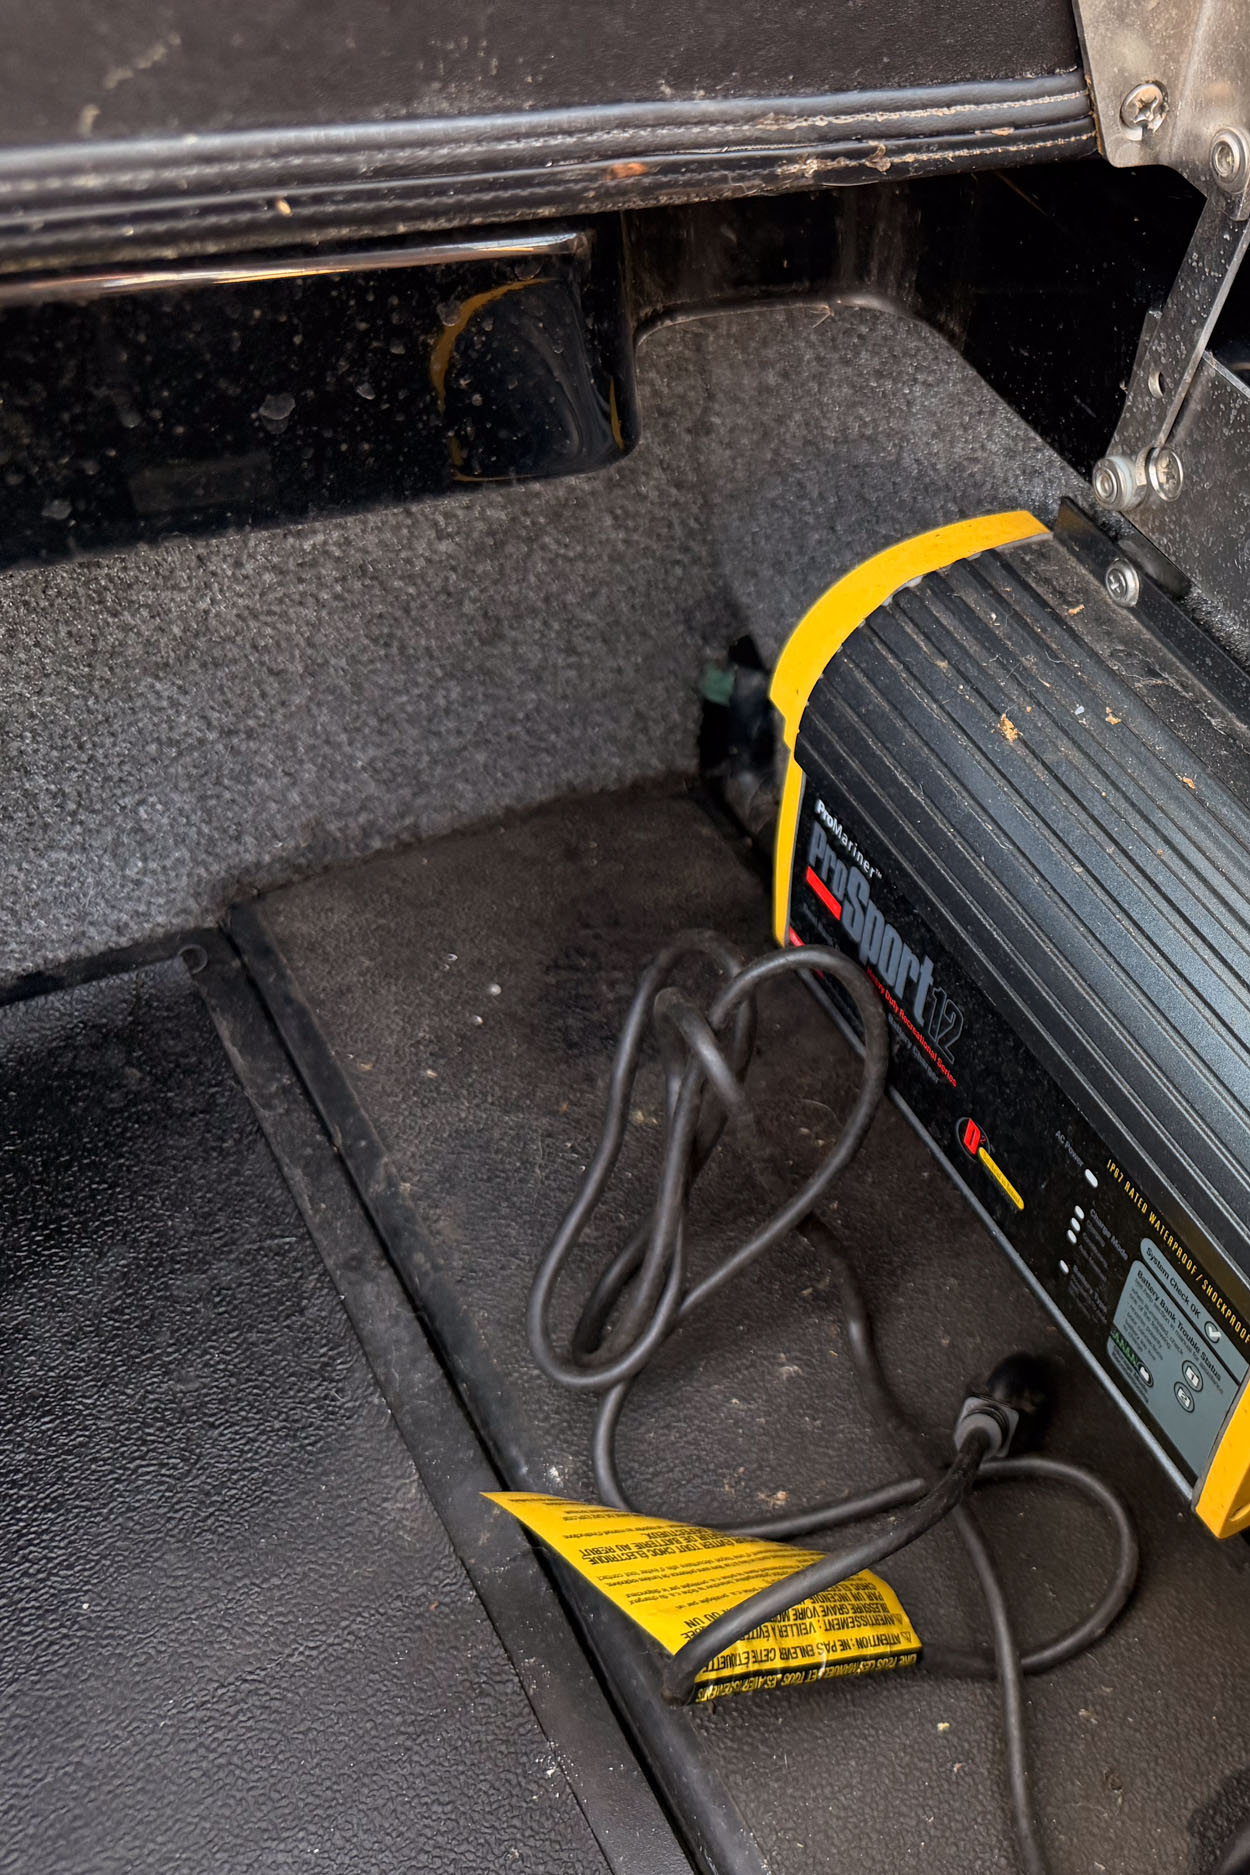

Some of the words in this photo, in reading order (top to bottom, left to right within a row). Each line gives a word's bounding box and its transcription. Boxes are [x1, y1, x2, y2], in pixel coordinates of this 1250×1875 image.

[807, 822, 934, 1026] ProSport
[898, 1007, 937, 1063] Recreational
[936, 1056, 957, 1088] Series
[1106, 1157, 1124, 1184] IP67
[1123, 1179, 1148, 1214] RATED
[1147, 1210, 1198, 1277] WATERPROOF
[1145, 1246, 1170, 1280] System
[1169, 1276, 1190, 1305] Check
[1189, 1301, 1201, 1319] OK
[1136, 1269, 1159, 1302] Battery
[1159, 1298, 1177, 1323] Bank
[1176, 1320, 1201, 1354] Trouble
[1199, 1351, 1222, 1382] Status
[791, 1605, 819, 1620] VOIRE
[818, 1602, 849, 1617] GRAVE
[683, 1616, 704, 1628] UN
[777, 1621, 815, 1637] VEILLER
[816, 1640, 836, 1653] PAS
[837, 1636, 850, 1650] NE
